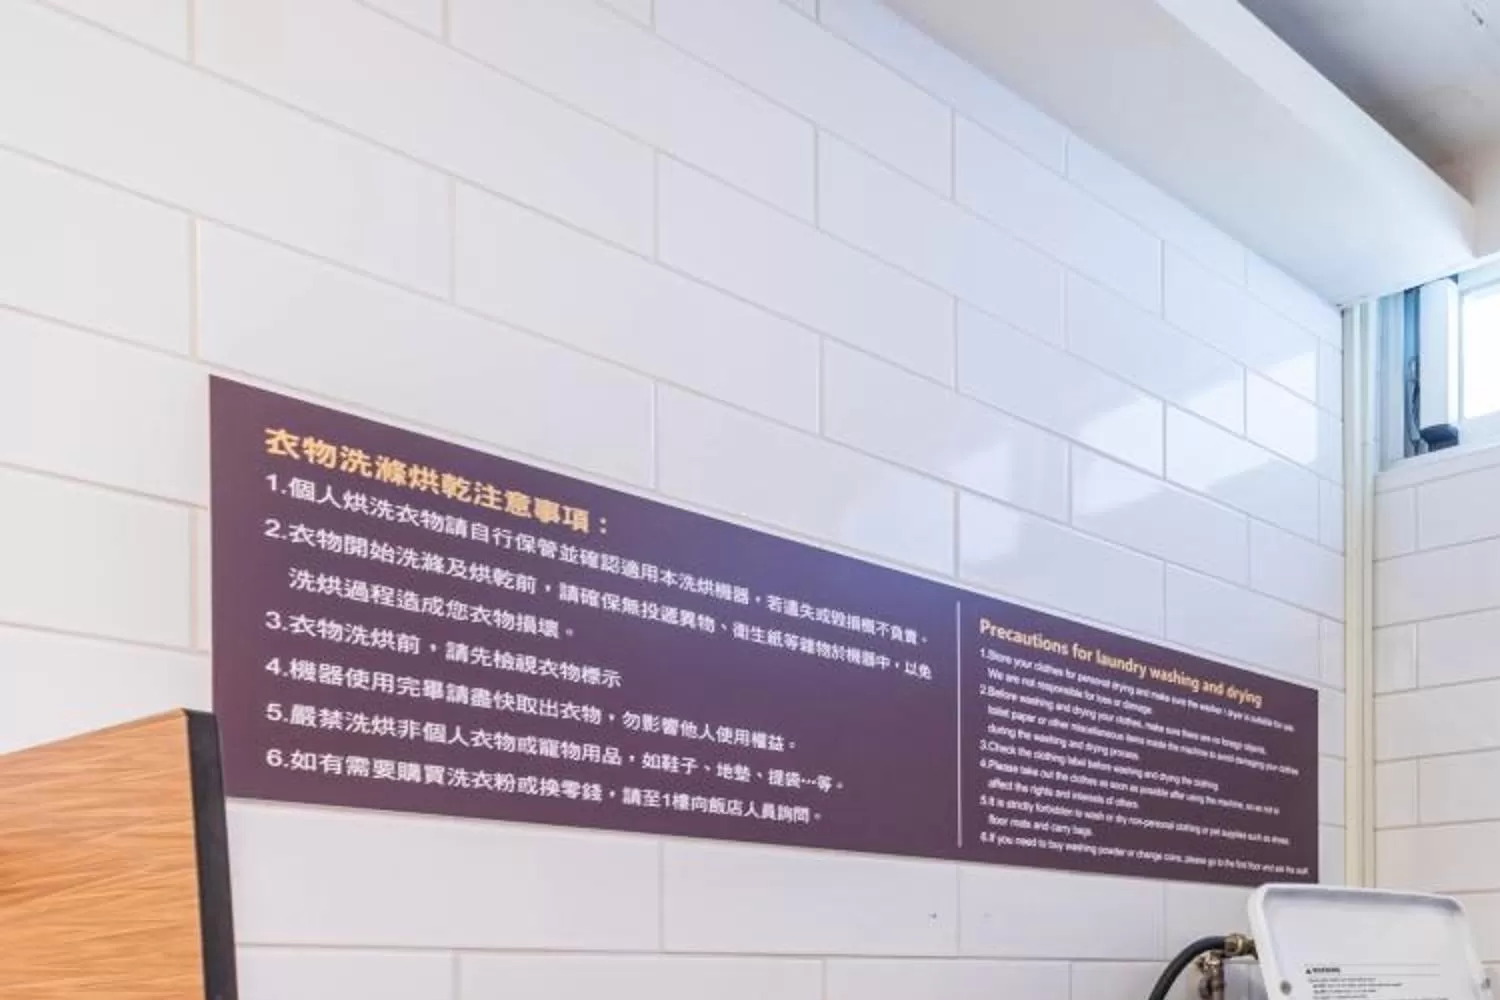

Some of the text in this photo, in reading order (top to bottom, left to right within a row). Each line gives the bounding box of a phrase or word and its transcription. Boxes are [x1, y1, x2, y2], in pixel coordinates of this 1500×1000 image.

[979, 617, 1263, 710] Precautions for laundry washing and drying
